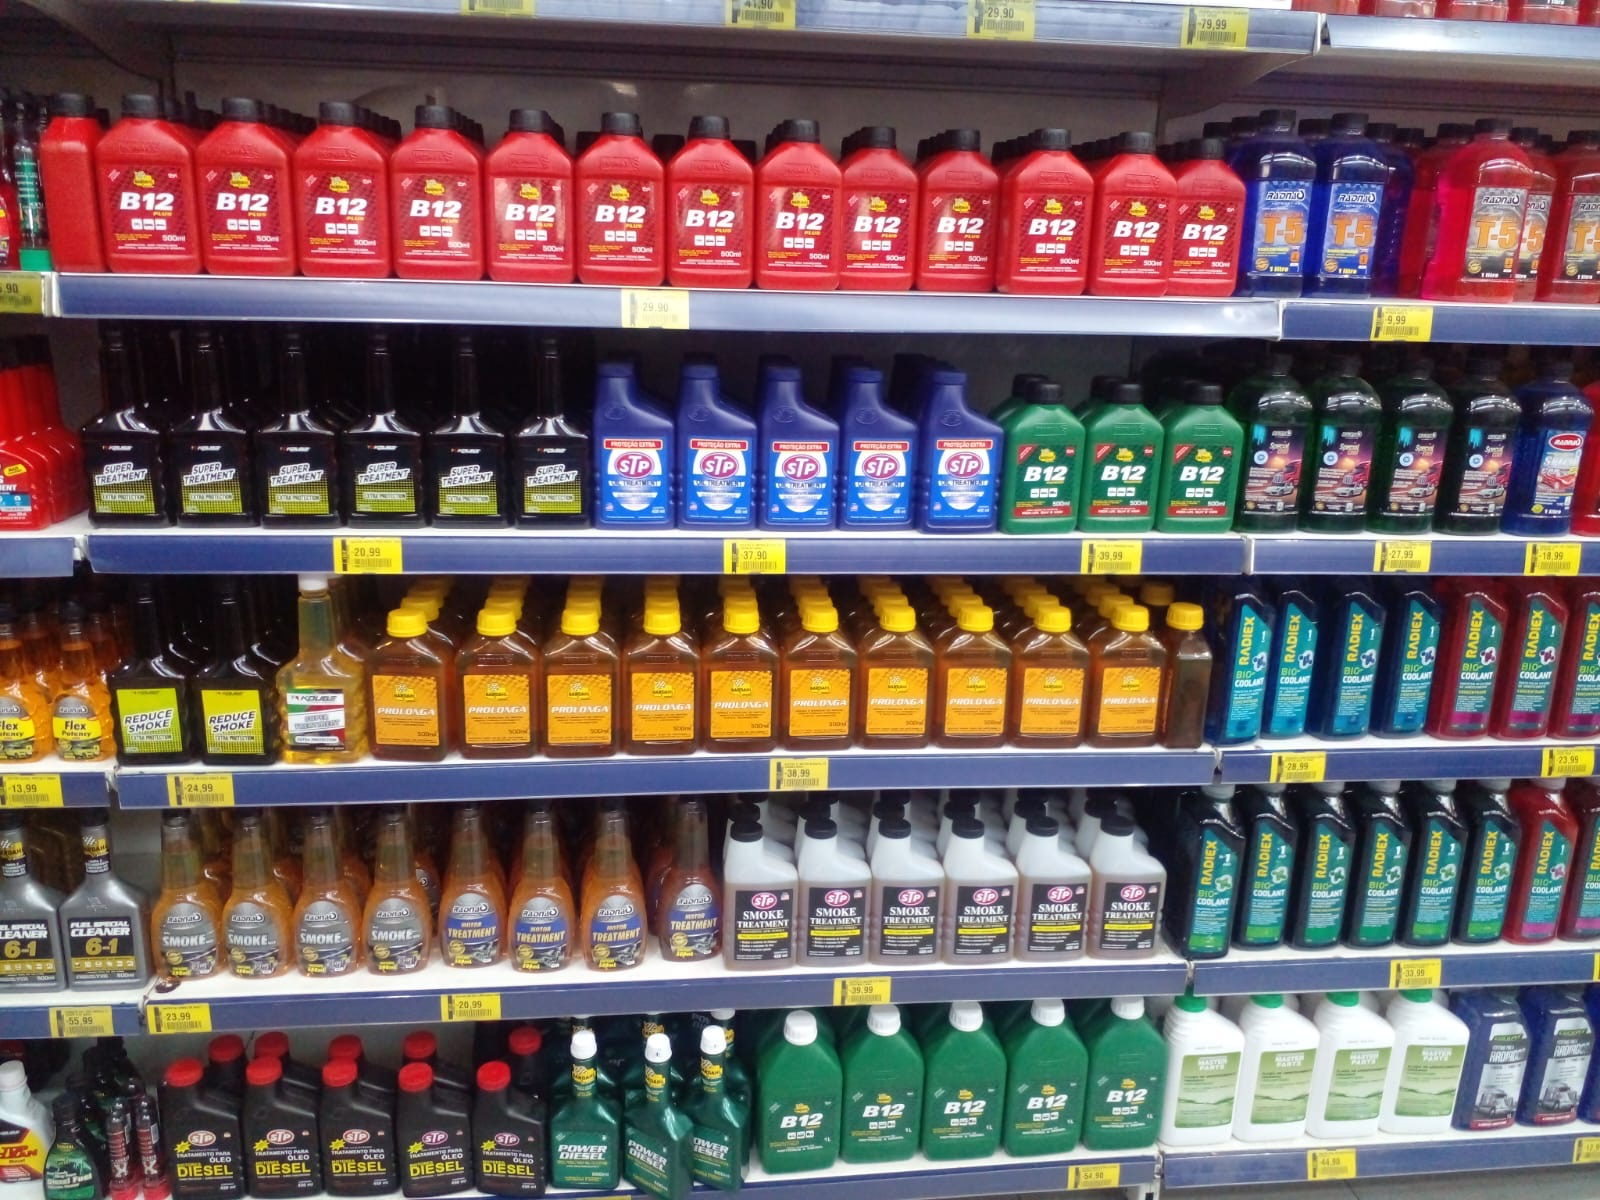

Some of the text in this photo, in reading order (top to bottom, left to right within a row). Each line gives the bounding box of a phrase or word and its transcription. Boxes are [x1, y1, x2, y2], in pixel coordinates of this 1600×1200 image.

[120, 192, 174, 211] B12
[216, 192, 269, 211] B12
[315, 197, 367, 216] B12
[410, 200, 462, 218] B12
[505, 204, 556, 222] B12
[595, 205, 646, 223] B12
[686, 210, 735, 228] B12
[776, 212, 824, 231] B12
[854, 216, 901, 234] B12
[937, 217, 984, 234] B12
[1028, 218, 1076, 236] B12
[1113, 221, 1160, 238] B12
[1182, 224, 1228, 241] B12
[1264, 216, 1304, 244] T-5
[1334, 218, 1374, 247] T-5
[1476, 220, 1518, 249] T-5
[104, 463, 132, 474] SUPER
[192, 463, 220, 474] SUPER
[280, 464, 309, 475] SUPER
[368, 462, 396, 473] SUPER
[537, 465, 564, 475] SUPER
[620, 456, 650, 475] STP
[705, 456, 735, 475] STP
[787, 458, 816, 476] STP
[867, 457, 894, 476] STP
[950, 456, 978, 474] STP
[96, 470, 146, 484] TREATMENT
[184, 470, 234, 485] TREATMENT
[271, 471, 322, 486] TREATMENT
[358, 470, 409, 484] TREATMENT
[528, 472, 577, 486] TREATMENT
[1024, 466, 1068, 481] B12
[1101, 466, 1146, 481] B12
[1180, 466, 1224, 481] B12
[1239, 617, 1255, 665] RADIEX
[1347, 614, 1364, 662] RADIEX
[1407, 612, 1424, 659] RADIEX
[1466, 610, 1484, 658] RADIEX
[1525, 610, 1543, 658] RADIEX
[1235, 677, 1264, 687] COOLANT
[1343, 675, 1373, 683] COOLANT
[1402, 672, 1432, 680] COOLANT
[1461, 672, 1493, 680] COOLANT
[1520, 671, 1552, 679] COOLANT
[125, 710, 172, 723] REDUCE
[378, 707, 435, 716] PROLONGA
[469, 706, 527, 714] PROLONGA
[209, 711, 255, 724] REDUCE
[65, 721, 86, 730] Flex
[129, 720, 169, 732] SMOKE
[213, 720, 253, 732] SMOKE
[1257, 833, 1272, 877] RADIEX
[1316, 834, 1331, 878] RADIEX
[1481, 831, 1498, 874] RADIEX
[1536, 831, 1554, 874] RADIEX
[1202, 841, 1217, 885] RADIEX
[827, 891, 848, 904] STP
[901, 891, 922, 903] STP
[975, 890, 996, 902] STP
[1123, 887, 1143, 899] STP
[754, 894, 775, 907] STP
[1111, 902, 1150, 911] SMOKE
[743, 910, 784, 920] SMOKE
[816, 908, 856, 917] SMOKE
[890, 907, 930, 916] SMOKE
[964, 906, 1004, 915] SMOKE
[1105, 912, 1154, 920] TREATMENT
[671, 918, 717, 930] TREATMENT
[737, 920, 789, 928] TREATMENT
[810, 917, 862, 925] TREATMENT
[958, 915, 1008, 923] TREATMENT
[70, 928, 130, 937] CLEANER
[300, 933, 341, 944] SMOKE
[372, 929, 413, 940] SMOKE
[448, 927, 496, 938] TREATMENT
[517, 932, 565, 943] TREATMENT
[86, 938, 118, 955] 6-1
[163, 935, 205, 946] SMOKE
[5, 940, 37, 958] 6-1
[1027, 1094, 1068, 1110] B12
[1107, 1089, 1148, 1102] B12
[863, 1104, 905, 1118] B12
[944, 1100, 986, 1114] B12
[780, 1113, 823, 1129] B12
[190, 1131, 213, 1144] STP
[269, 1130, 291, 1143] STP
[426, 1132, 445, 1143] STP
[499, 1134, 516, 1145] STP
[558, 1145, 607, 1153] POWER
[560, 1152, 605, 1160] DIESEL
[628, 1139, 667, 1164] POWER
[209, 1154, 232, 1163] ÓLEO
[629, 1149, 665, 1173] DIESEL
[177, 1164, 233, 1177] DIESEL
[256, 1162, 311, 1175] DIESEL
[410, 1161, 464, 1176] DIESEL
[483, 1161, 534, 1176] DIESEL
